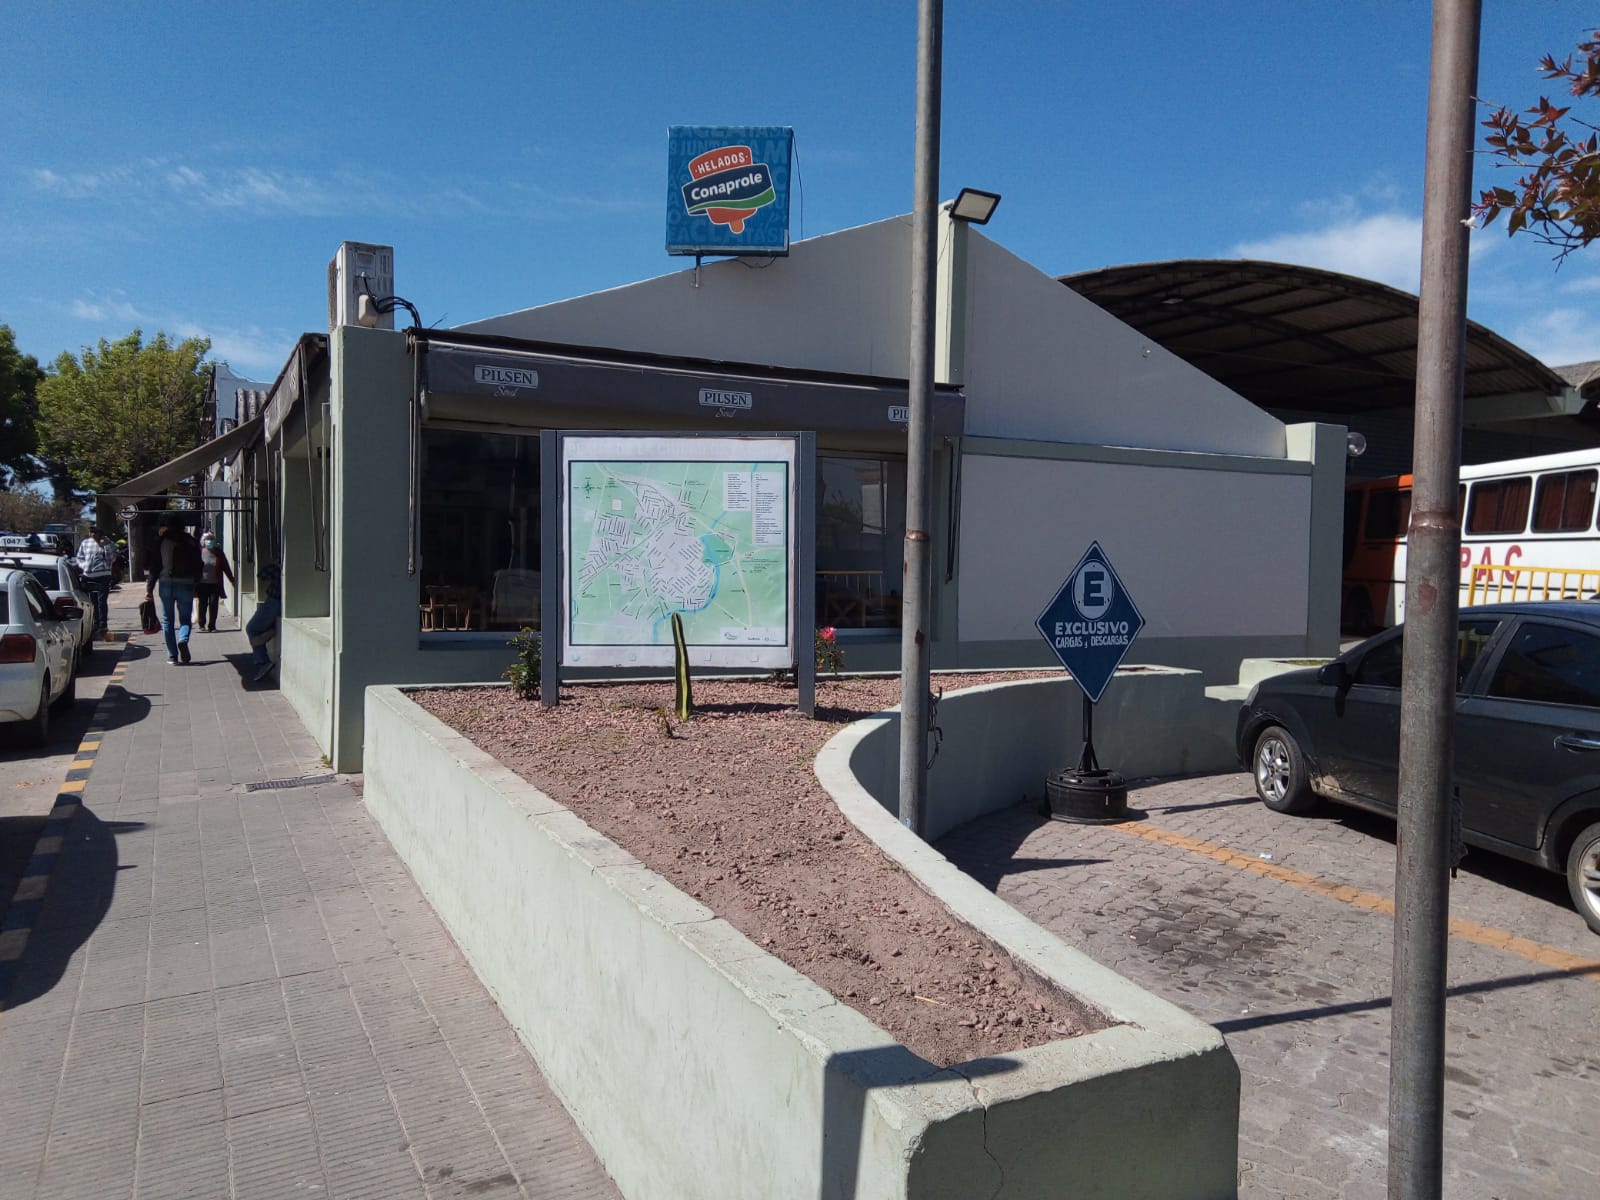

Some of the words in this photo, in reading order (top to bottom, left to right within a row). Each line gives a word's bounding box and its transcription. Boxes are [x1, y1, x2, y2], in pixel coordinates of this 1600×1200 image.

[697, 151, 745, 175] HELADOS
[691, 172, 763, 200] Conaprole
[481, 368, 532, 385] PILSEN
[704, 391, 747, 405] PILSEN
[1084, 571, 1105, 607] E
[1055, 621, 1129, 636] EXCLUSIVO
[1056, 636, 1083, 649] CARGAS
[1091, 635, 1129, 647] DESCARGAS
